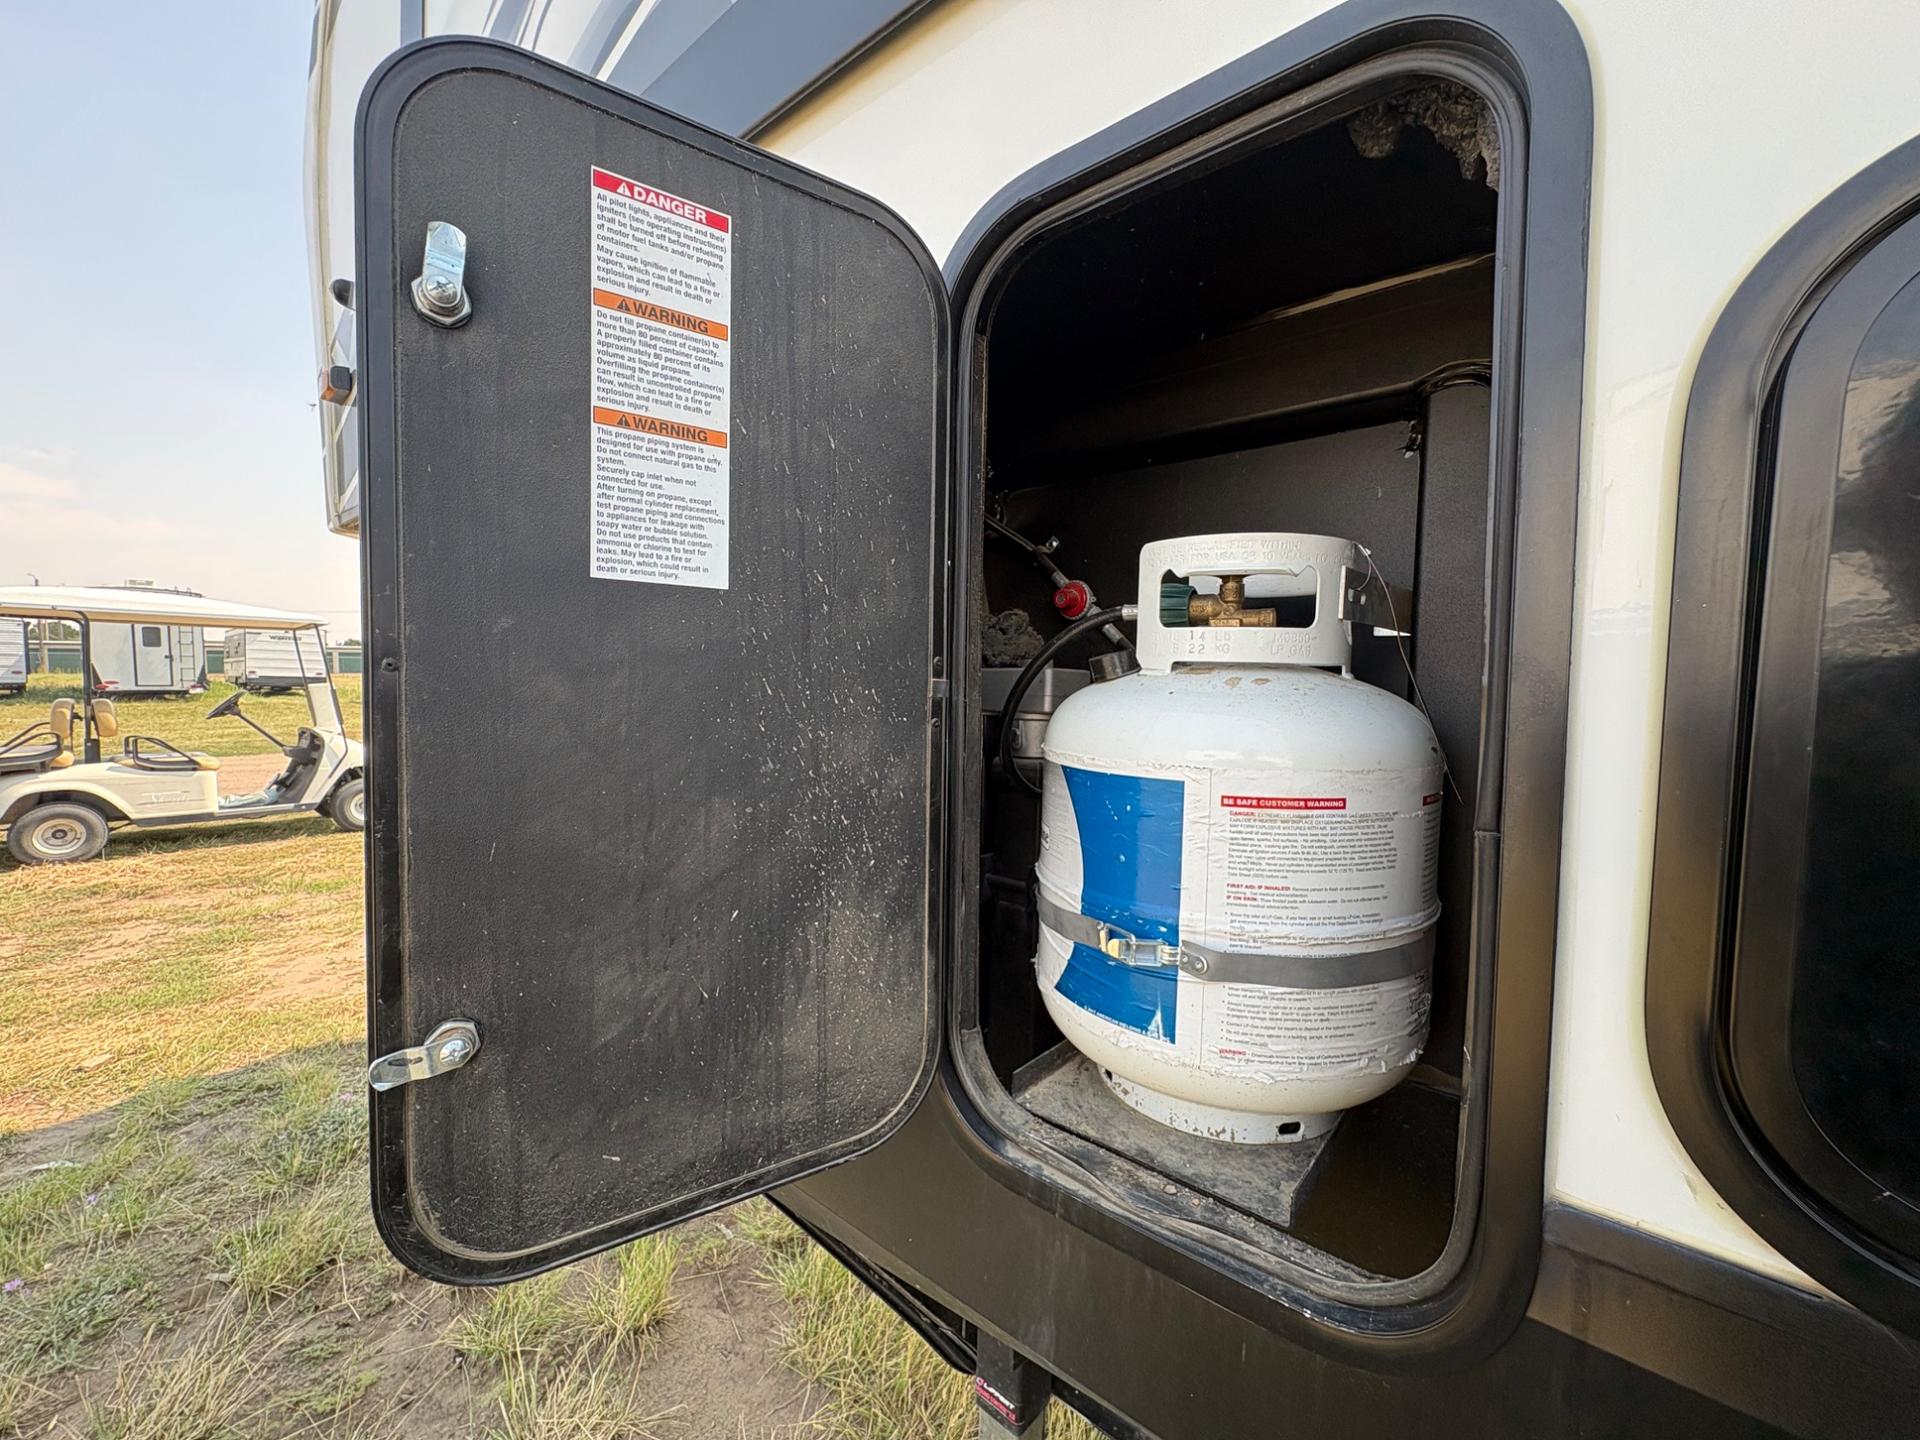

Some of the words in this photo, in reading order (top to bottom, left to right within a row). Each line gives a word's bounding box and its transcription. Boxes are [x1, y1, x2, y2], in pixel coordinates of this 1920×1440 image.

[596, 192, 607, 202] All
[609, 196, 626, 211] pilot
[628, 203, 651, 219] lights,
[654, 212, 692, 233] appliances
[694, 226, 707, 237] and
[709, 231, 724, 243] their
[633, 186, 706, 224] DANGER
[596, 202, 626, 220] igniters
[628, 213, 644, 227] (see
[646, 219, 681, 239] operating
[683, 232, 726, 254] instructions)
[597, 212, 615, 225] shall
[618, 219, 627, 229] be
[629, 223, 654, 238] turned
[656, 232, 665, 241] off
[667, 236, 690, 250] before
[692, 244, 722, 262] refueling
[596, 232, 639, 252] containers.
[596, 222, 604, 231] of
[607, 225, 629, 239] motor
[632, 233, 646, 244] fuel
[648, 239, 668, 252] tanks
[671, 246, 694, 260] and/or
[696, 256, 723, 271] propane
[596, 244, 613, 257] May
[615, 251, 638, 263] cause
[640, 258, 668, 274] ignition
[670, 267, 677, 275] of
[679, 270, 715, 287] flammable
[597, 273, 625, 288] serious
[627, 282, 650, 297] injury.
[597, 309, 607, 319] Do
[609, 313, 622, 322] not
[624, 317, 633, 326] fill
[636, 321, 666, 336] propane
[668, 329, 710, 348] container(s)
[632, 301, 708, 333] WARNING
[596, 320, 616, 331] more
[619, 325, 636, 336] than
[638, 330, 647, 338] 80
[649, 333, 677, 348] percent
[688, 343, 718, 359] capacity.
[604, 330, 636, 347] properly
[638, 339, 657, 350] filled
[659, 344, 692, 359] container
[694, 354, 723, 367] contains
[596, 347, 625, 360] volume
[638, 357, 658, 370] liquid
[660, 364, 692, 378] propane.
[597, 338, 651, 359] approximately
[653, 352, 662, 360] 80
[664, 355, 691, 369] percent
[596, 357, 636, 374] Overfilling
[638, 366, 649, 375] the
[652, 371, 681, 384] propane
[683, 377, 724, 394] container(s)
[596, 367, 611, 375] can
[613, 370, 635, 381] result
[646, 377, 691, 394] uncontrolled
[693, 390, 720, 402] propane
[596, 394, 624, 406] serious
[627, 400, 649, 413] injury.
[597, 427, 612, 436] This
[615, 432, 645, 444] propane
[647, 436, 669, 448] piping
[671, 441, 696, 453] system
[632, 416, 707, 442] WARNING
[596, 454, 625, 467] system.
[597, 436, 631, 450] designed
[660, 448, 675, 456] with
[677, 452, 705, 464] propane
[596, 464, 629, 477] Securely
[631, 471, 644, 479] cap
[646, 472, 662, 480] inlet
[664, 475, 683, 484] when
[596, 473, 635, 485] connected
[596, 482, 615, 491] After
[617, 485, 644, 497] turning
[657, 493, 687, 504] propane,
[689, 496, 711, 507] except
[597, 491, 614, 500] after
[616, 494, 642, 504] normal
[644, 498, 672, 510] cylinder
[674, 503, 718, 517] replacement,
[597, 500, 611, 509] test
[613, 504, 643, 515] propane
[645, 508, 667, 518] piping
[684, 513, 724, 524] connections
[606, 511, 646, 524] appliances
[660, 518, 687, 530] leakage
[596, 520, 619, 530] soapy
[621, 522, 642, 531] water
[653, 526, 677, 535] bubble
[679, 530, 708, 539] solution.
[638, 533, 669, 545] products
[687, 539, 712, 548] contain
[596, 555, 634, 567] explosion,
[636, 559, 658, 568] which
[1263, 551, 1275, 560] 10
[596, 564, 617, 572] death
[629, 568, 656, 576] serious
[658, 570, 679, 580] injury.
